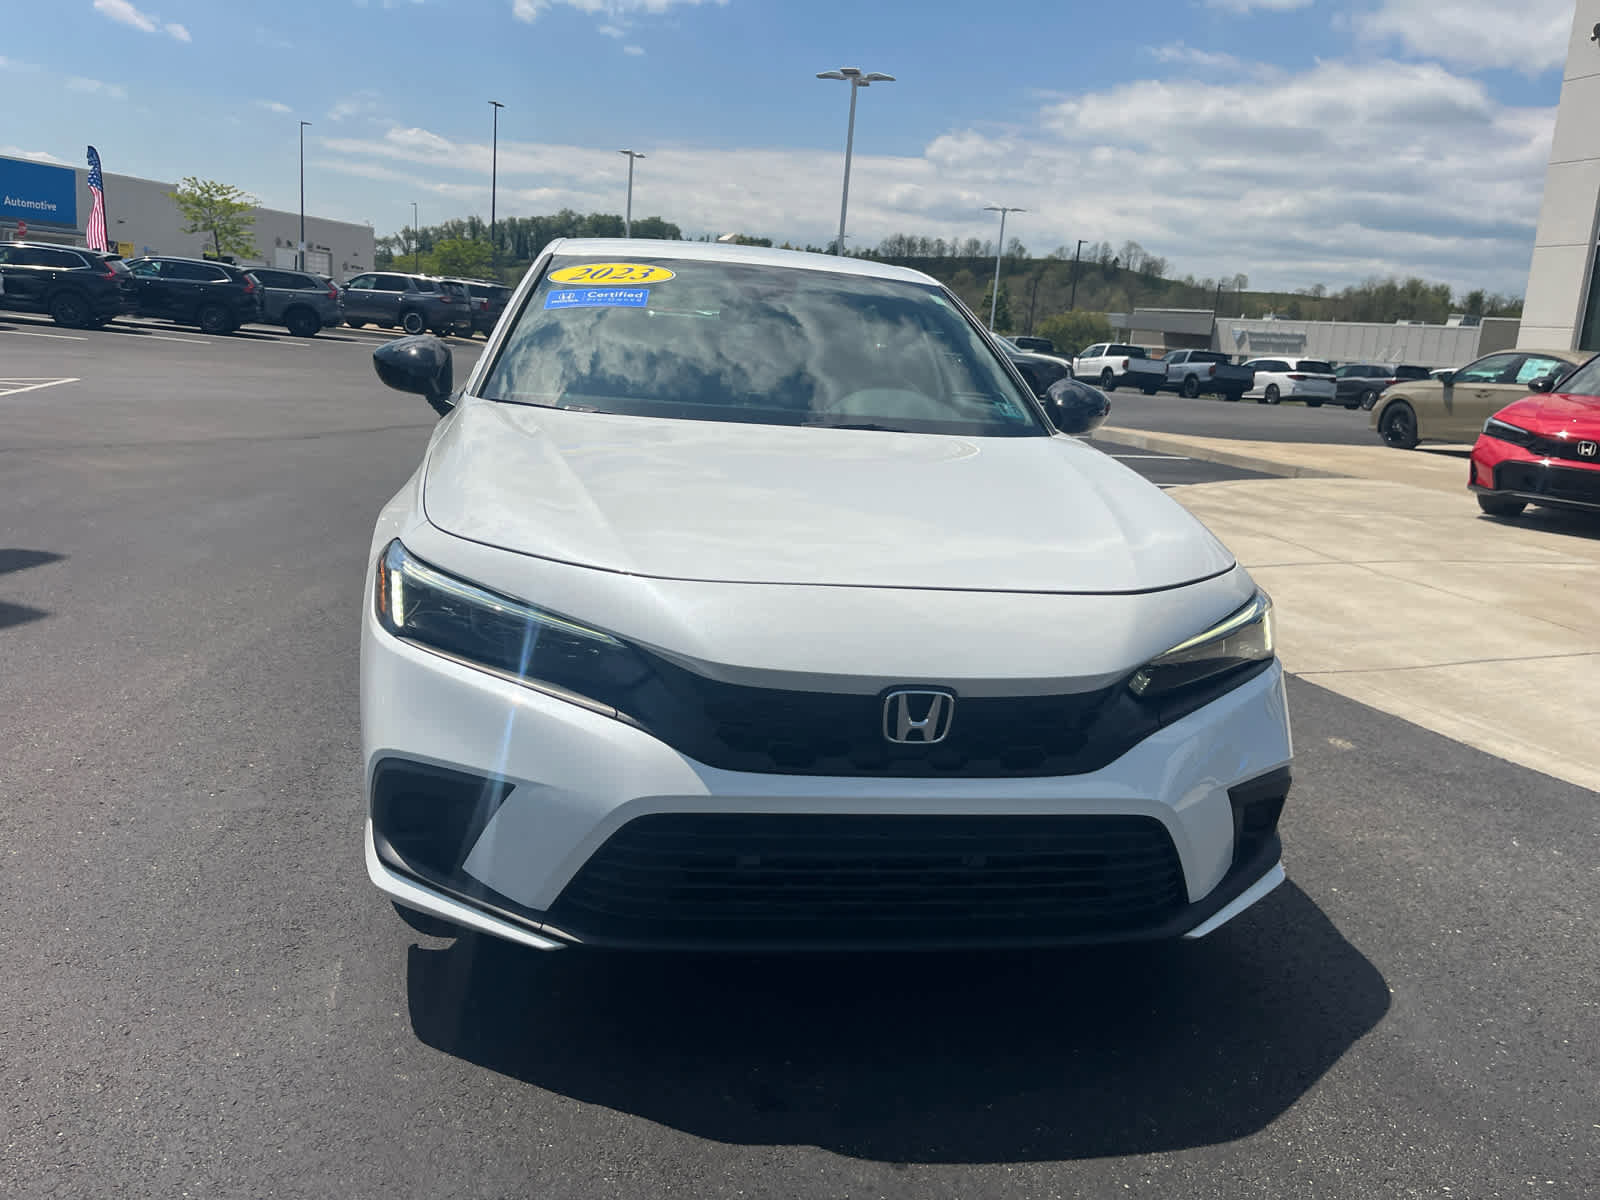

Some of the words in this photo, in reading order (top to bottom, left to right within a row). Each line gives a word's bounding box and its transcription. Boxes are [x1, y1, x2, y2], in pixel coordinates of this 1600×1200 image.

[4, 195, 57, 211] Automotive
[567, 267, 655, 281] 2023
[587, 291, 644, 299] Certified
